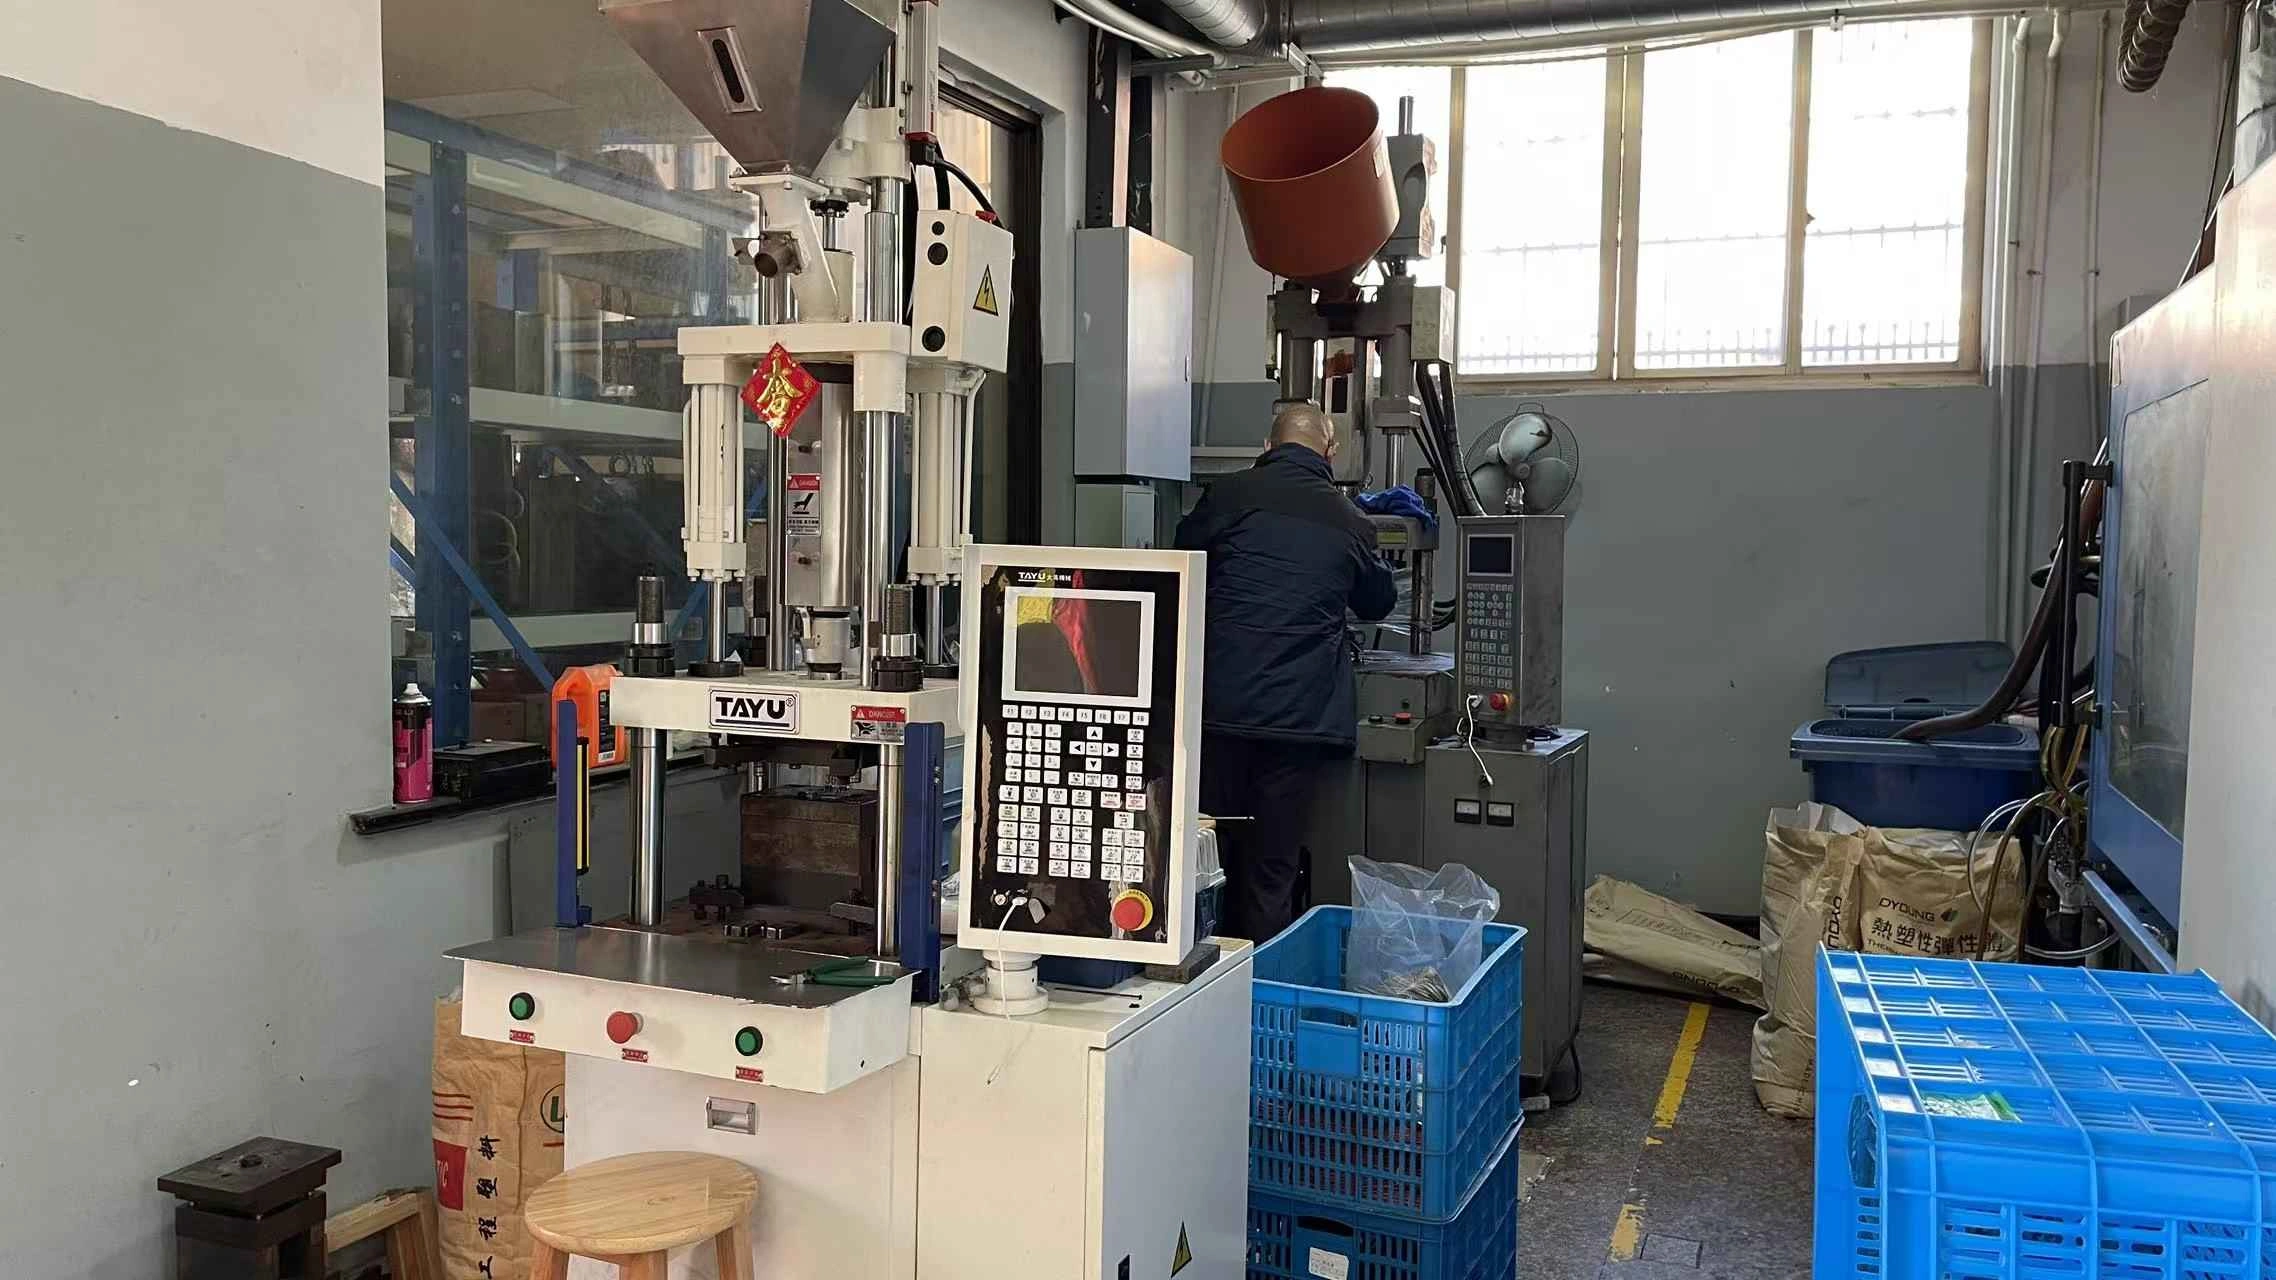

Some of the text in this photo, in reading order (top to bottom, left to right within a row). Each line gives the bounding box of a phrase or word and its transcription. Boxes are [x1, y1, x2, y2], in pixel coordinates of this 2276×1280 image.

[1018, 572, 1046, 580] TAYU
[1827, 895, 1843, 948] DYOU
[1879, 896, 1935, 922] DYOUNG
